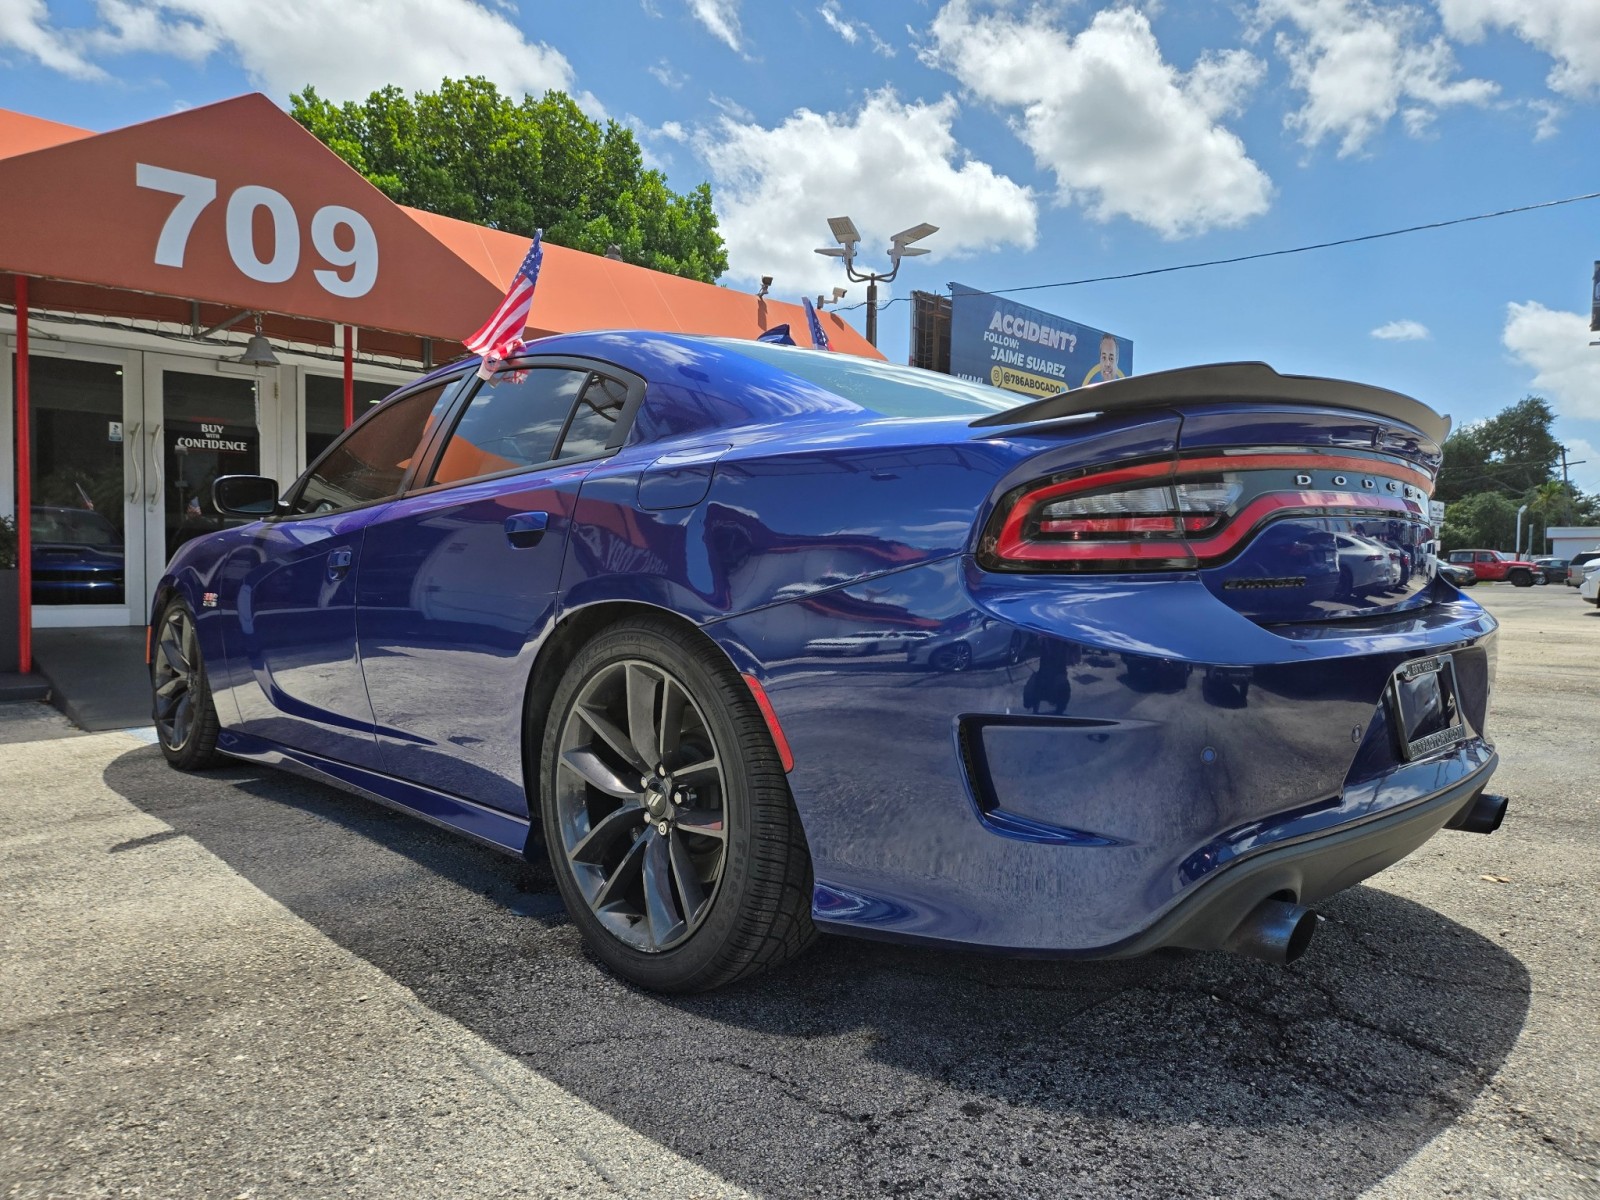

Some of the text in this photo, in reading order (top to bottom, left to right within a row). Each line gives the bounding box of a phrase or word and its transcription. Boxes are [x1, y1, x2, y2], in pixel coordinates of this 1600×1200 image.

[136, 162, 379, 298] 709
[984, 331, 1020, 349] FOLLOW:
[989, 311, 1077, 353] ACCIDENT?
[990, 346, 1066, 378] JAIME SUAREZ
[1003, 372, 1061, 394] @786ABOGADO
[201, 423, 224, 434] BUY
[177, 437, 248, 452] CONFIDENCE
[1295, 474, 1413, 498] DODGE
